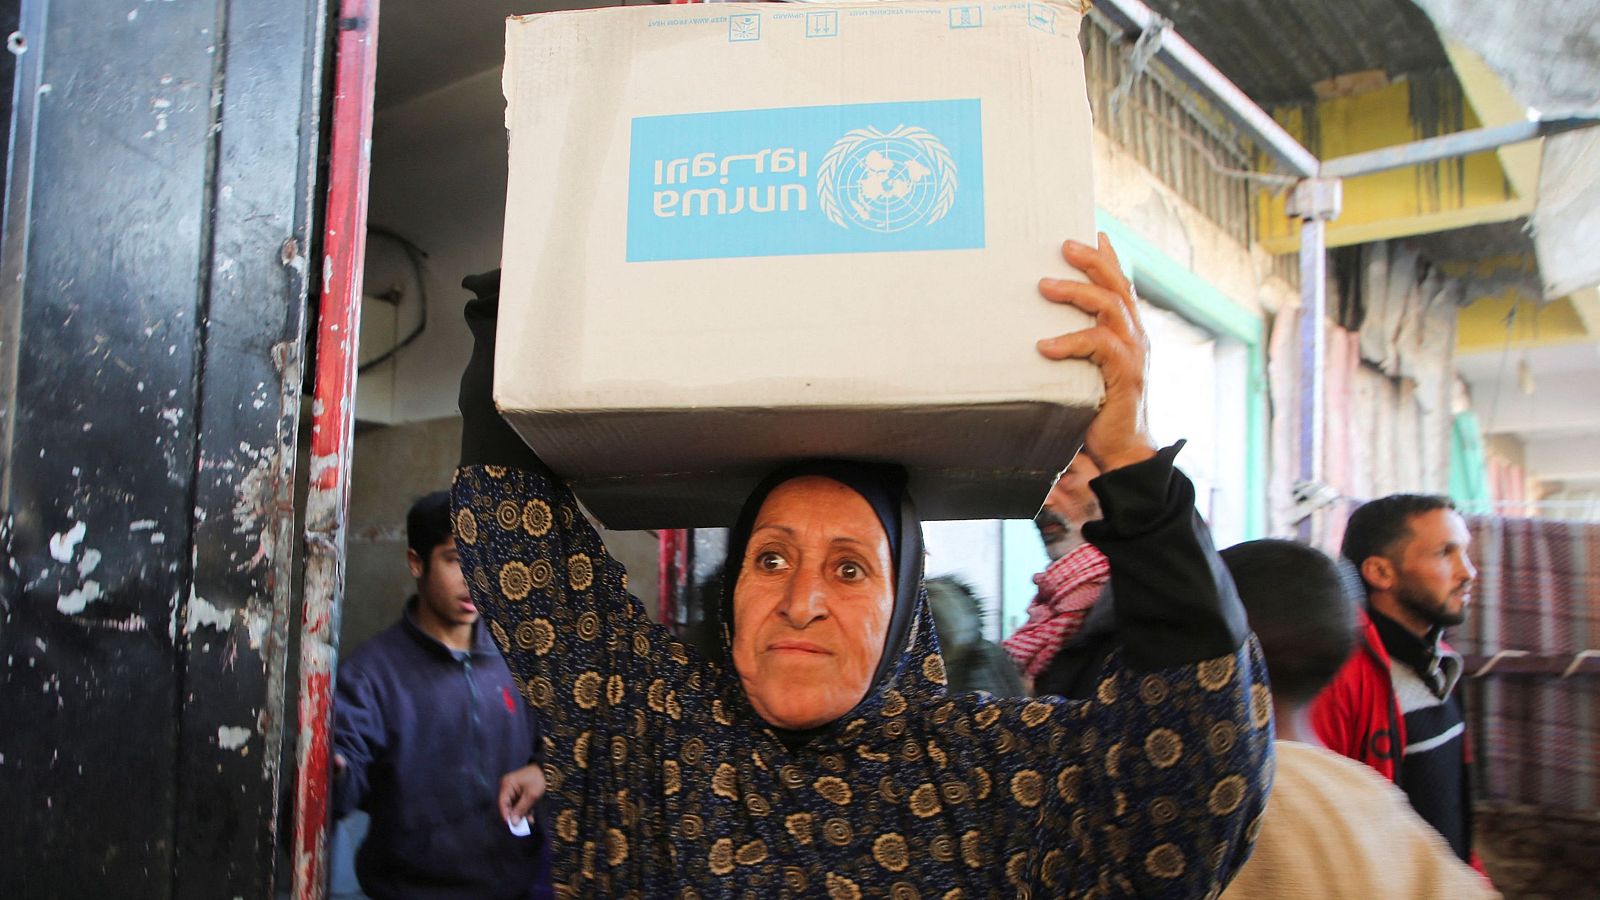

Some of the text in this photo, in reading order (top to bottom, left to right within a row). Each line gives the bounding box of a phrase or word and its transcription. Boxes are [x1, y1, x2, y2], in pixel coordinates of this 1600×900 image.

[647, 16, 729, 28] KEEP AWAY FROM HEAT
[773, 12, 805, 20] UPWARD
[653, 184, 808, 219] unrwa
